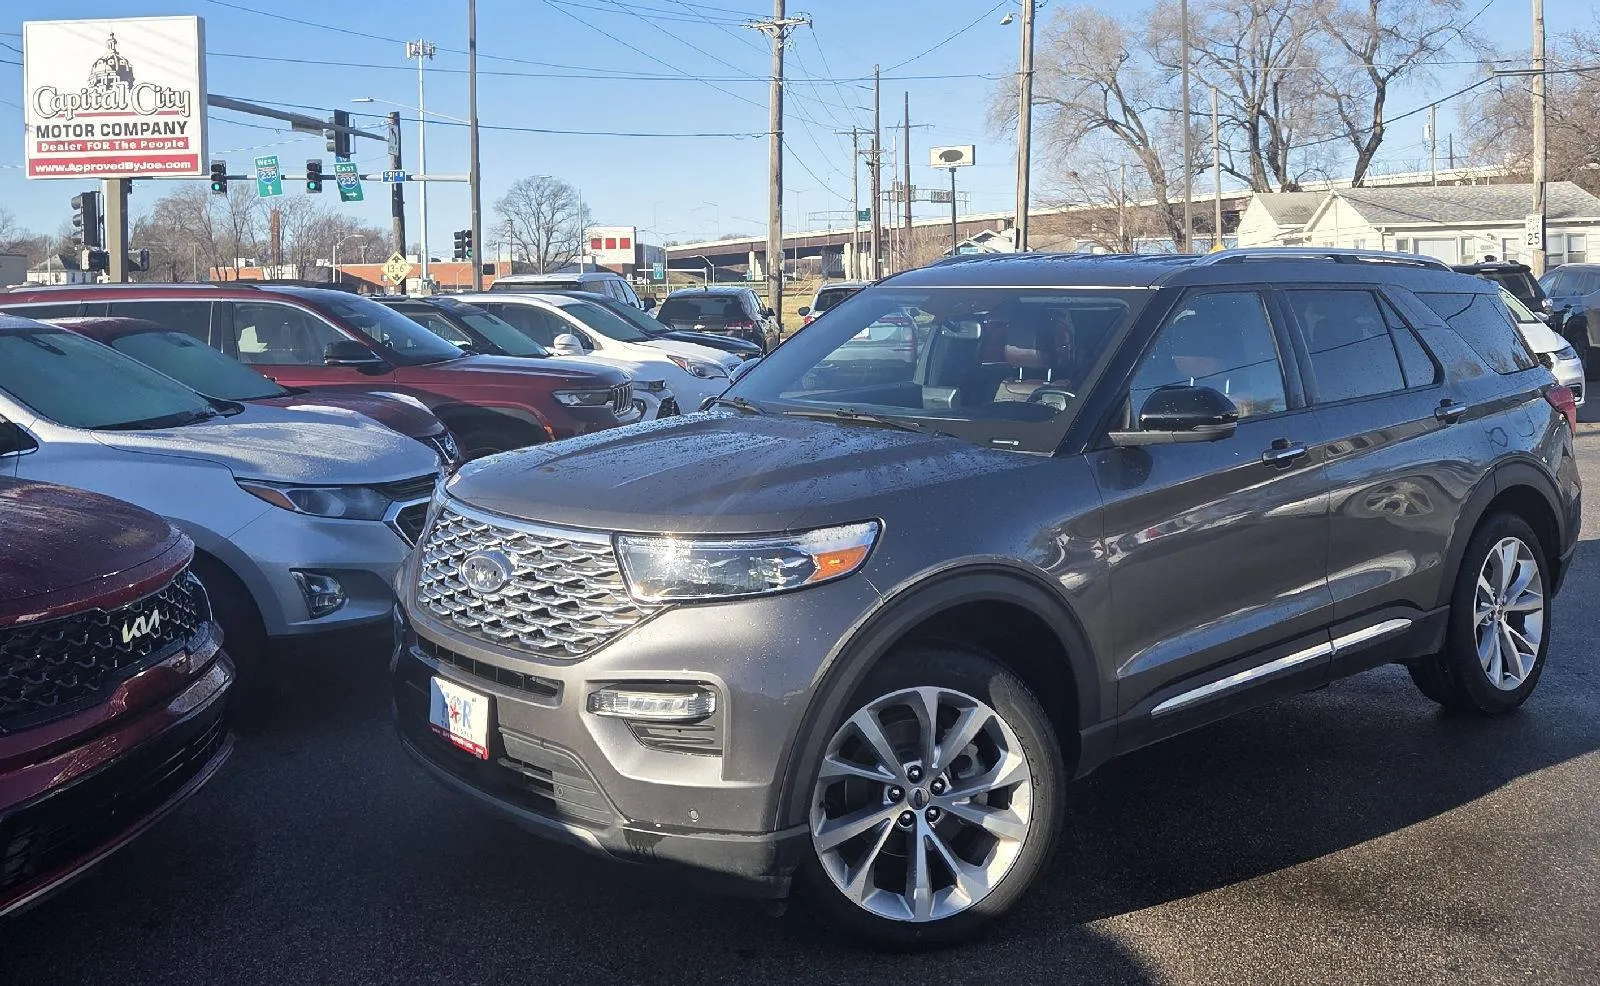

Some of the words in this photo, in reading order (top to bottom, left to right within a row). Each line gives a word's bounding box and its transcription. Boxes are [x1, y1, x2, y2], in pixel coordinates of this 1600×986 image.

[33, 84, 128, 121] Capital
[131, 82, 191, 117] City
[36, 123, 95, 138] MOTOR
[100, 121, 188, 137] COMPANY
[41, 142, 82, 152] Dealer
[86, 142, 111, 151] FOR
[113, 141, 137, 150] The
[140, 139, 185, 149] People
[35, 160, 191, 173] www.ApprovedByJoe.com
[257, 158, 276, 166] WEST
[261, 170, 277, 180] 235
[340, 176, 356, 185] 235
[1527, 232, 1540, 246] 25
